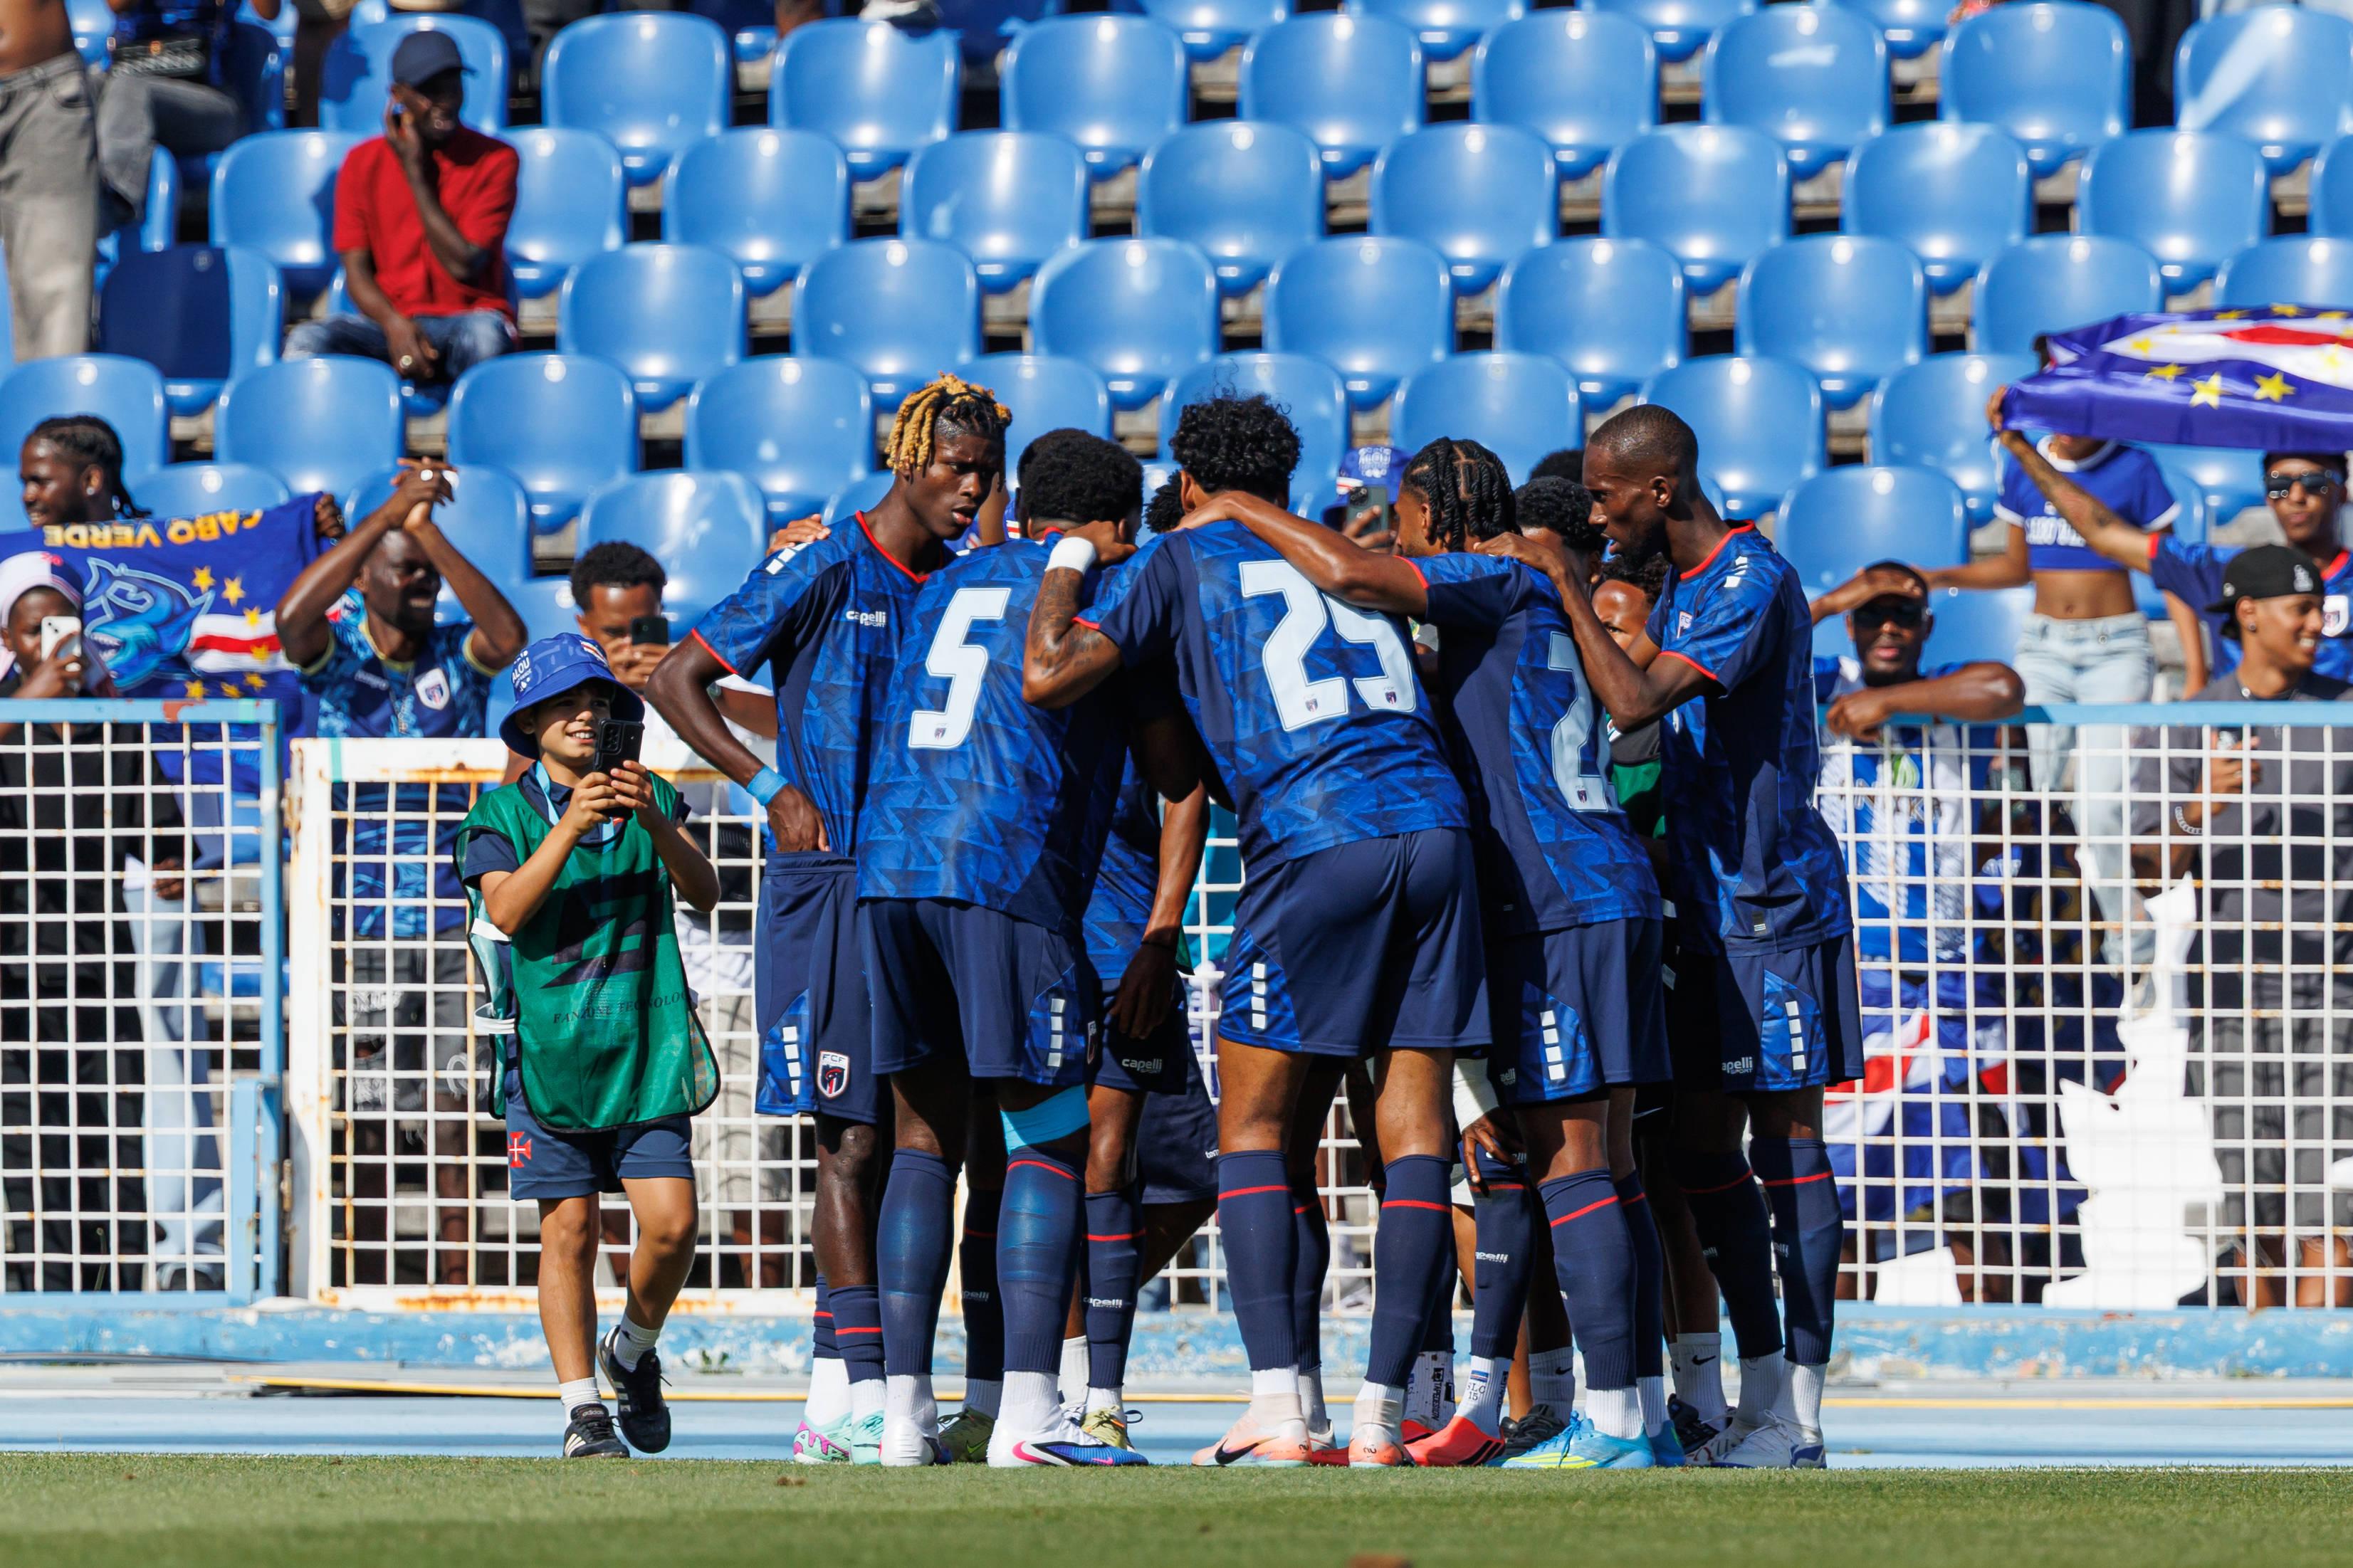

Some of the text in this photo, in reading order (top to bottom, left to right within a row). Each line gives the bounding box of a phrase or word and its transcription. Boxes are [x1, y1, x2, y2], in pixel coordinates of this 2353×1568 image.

[43, 508, 264, 549] CABO VERDE
[846, 610, 886, 624] capelli
[908, 587, 1012, 749] 5
[822, 1053, 846, 1064] FCF
[1121, 1058, 1163, 1071] capelli
[1721, 1056, 1753, 1073] apelli
[963, 1290, 990, 1300] pelli
[1467, 1382, 1487, 1394] SLC
[1468, 1391, 1479, 1401] 15
